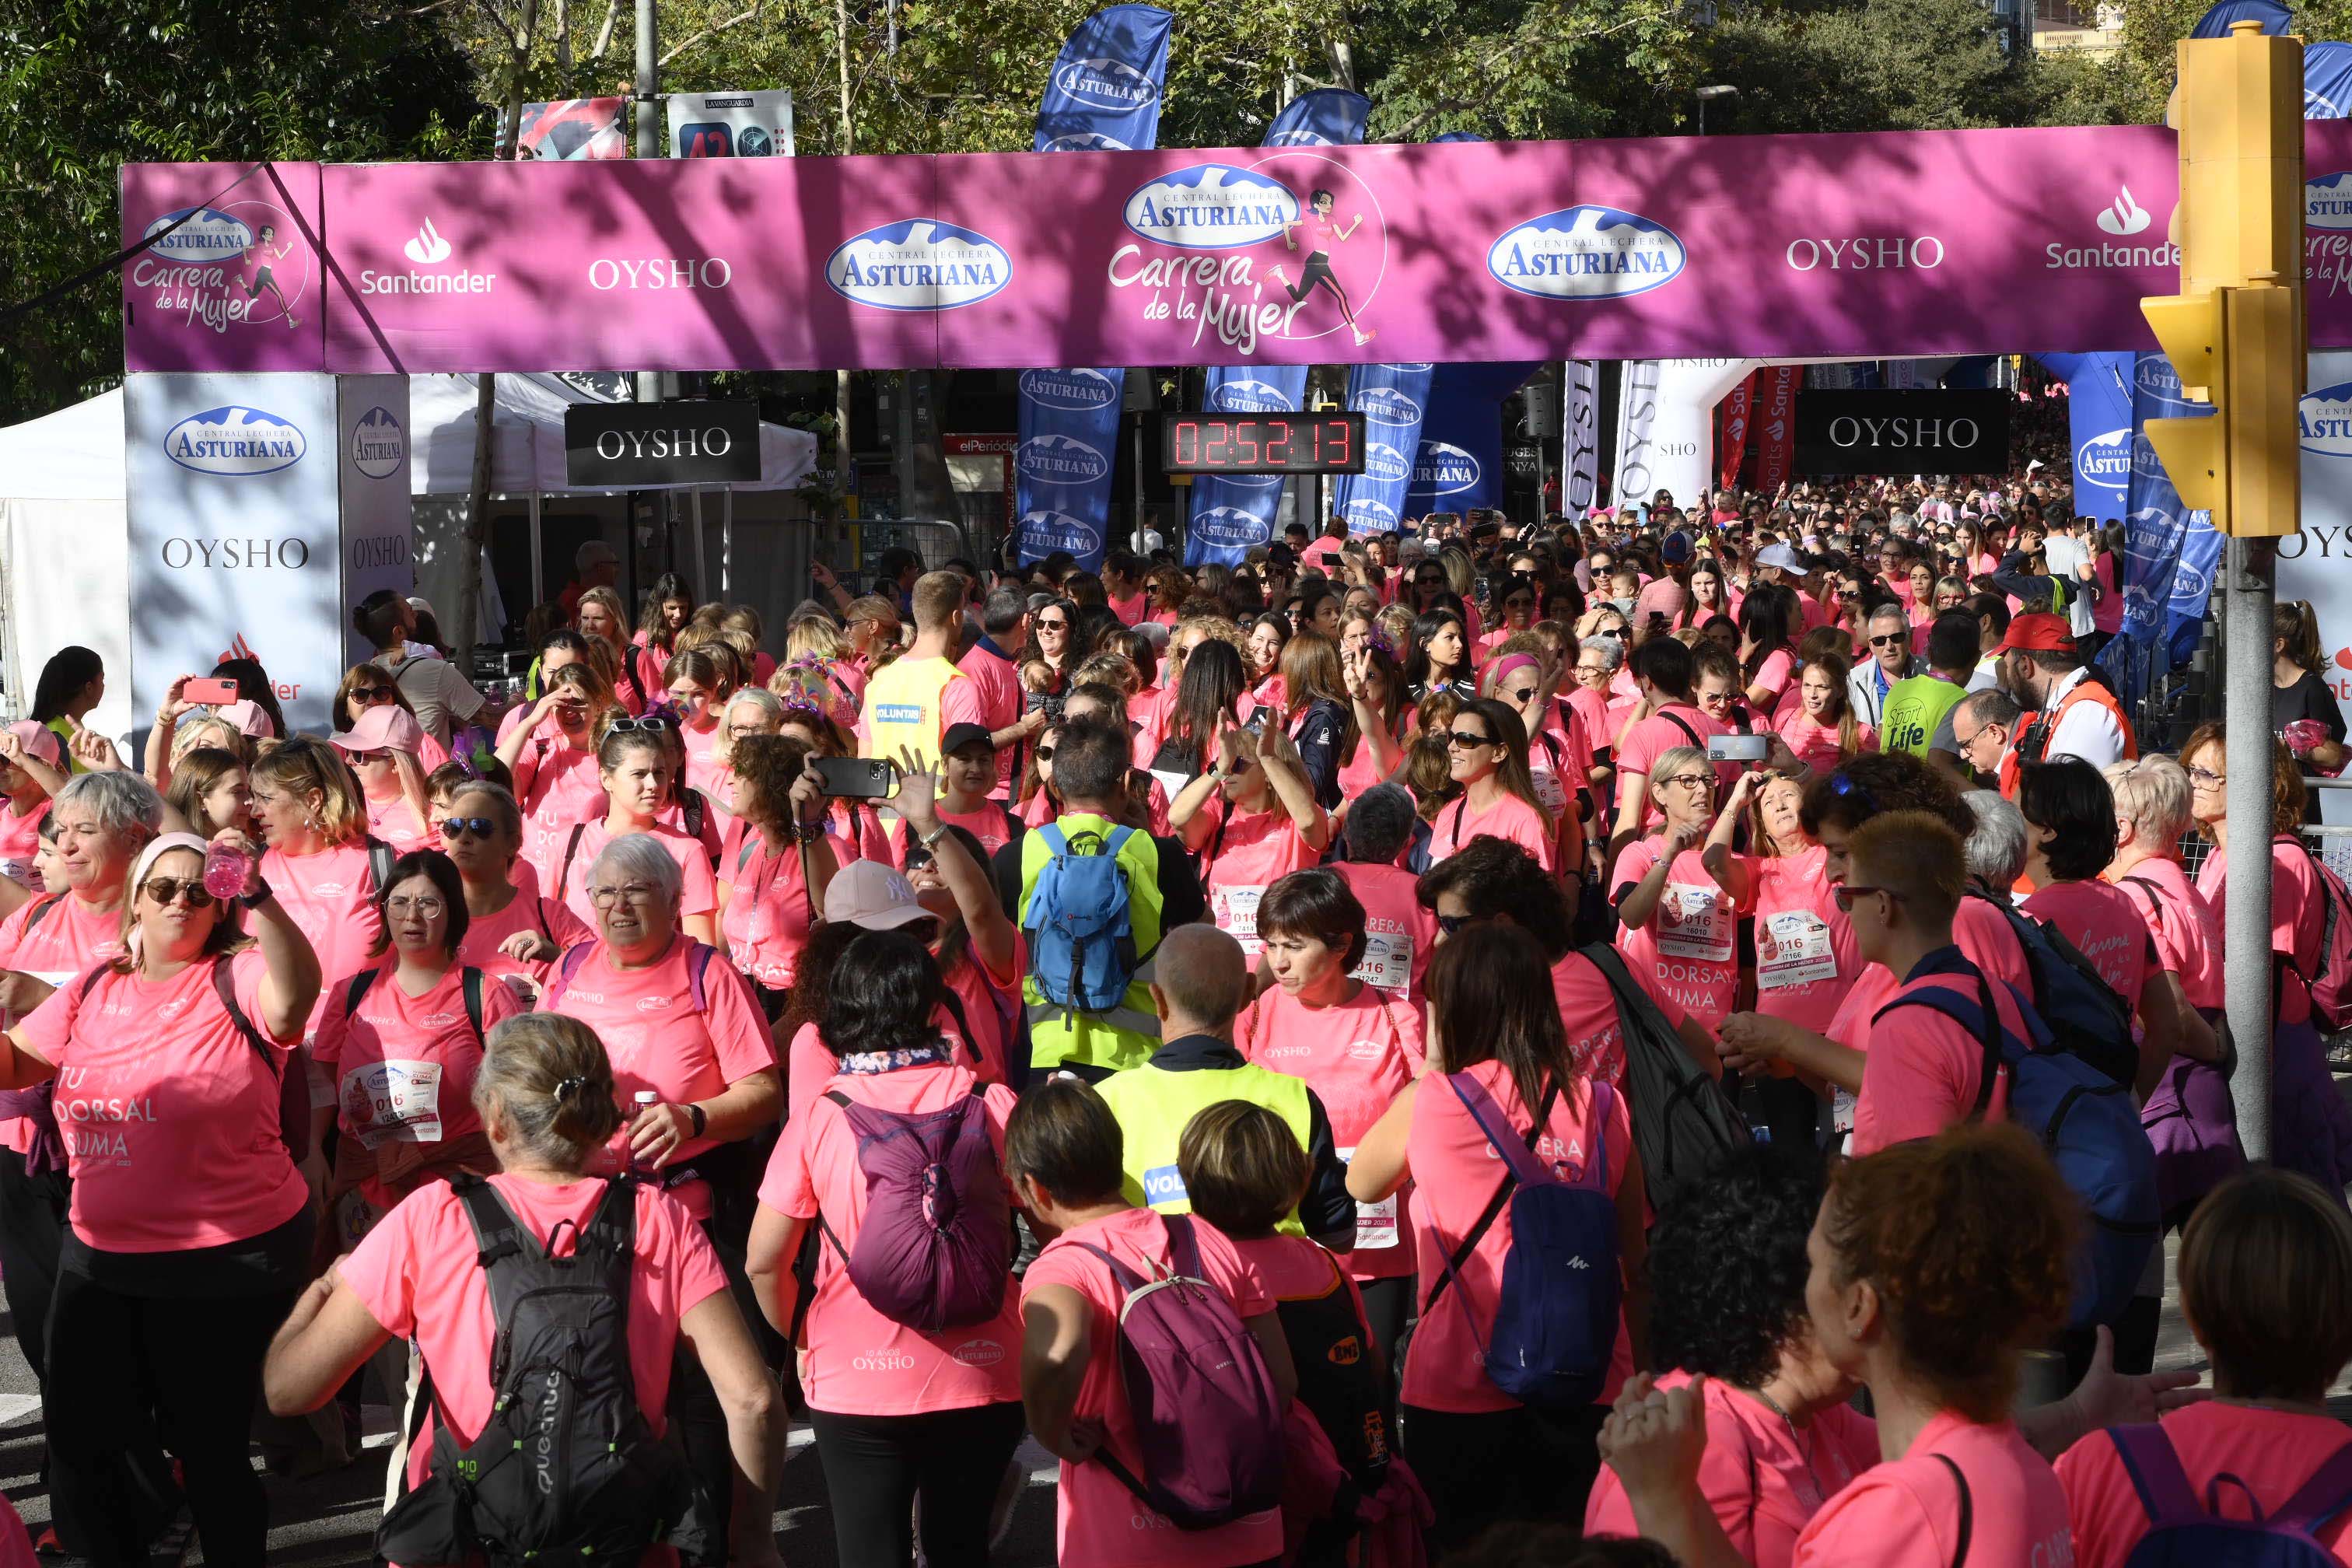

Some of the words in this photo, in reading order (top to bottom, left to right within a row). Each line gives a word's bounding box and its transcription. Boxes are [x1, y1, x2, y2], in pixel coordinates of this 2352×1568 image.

[1062, 70, 1148, 102] ASTURIANA
[1164, 193, 1219, 202] CENTRAL
[1225, 192, 1281, 201] LECHERA
[1136, 196, 1285, 227] ASTURIANA
[1533, 238, 1595, 248] CENTRAL
[1601, 236, 1665, 247] LECHERA
[1787, 236, 1944, 271] OYSHO
[868, 250, 926, 260] CENTRAL
[933, 249, 992, 260] LECHERA
[1108, 243, 1254, 288] Carrera
[1503, 243, 1670, 277] ASTURIANA
[2046, 241, 2182, 269] Santande
[133, 259, 226, 288] Carrera
[588, 257, 733, 291] OYSHO
[839, 254, 997, 287] ASTURIANA
[2318, 257, 2332, 279] la
[360, 268, 496, 294] Santander
[156, 289, 173, 310] de
[176, 289, 189, 310] la
[187, 285, 260, 334] Mujer
[1143, 289, 1171, 320] de
[1176, 288, 1197, 320] la
[1192, 282, 1308, 355] Mujer
[1027, 373, 1108, 402] ASTURIANA
[1356, 396, 1415, 422] ASTURIANA
[597, 427, 732, 460] OYSHO
[1175, 421, 1350, 465] 02:52:13
[1829, 417, 1979, 448] OYSHO
[175, 432, 297, 458] ASTURIANA
[355, 433, 401, 461] ASTURIANA
[1022, 448, 1100, 475] ASTURIANA
[1366, 458, 1403, 477] TURIANA
[1020, 530, 1092, 552] STURIANA
[1196, 518, 1262, 541] ASTURIANA
[162, 537, 309, 569] OYSHO
[353, 534, 405, 569] OYSHO
[1888, 705, 1923, 728] Sport
[1888, 722, 1924, 752] Life
[1234, 913, 1258, 922] 016
[1365, 918, 1406, 935] RERA
[1684, 913, 1711, 926] 016
[1686, 926, 1707, 936] 16010
[1661, 943, 1685, 952] OYSHO
[1778, 937, 1804, 952] 016
[1782, 951, 1802, 961] 17166
[1356, 961, 1383, 973] 016
[1764, 973, 1786, 982] OYSHO
[1804, 966, 1830, 976] Santander
[566, 989, 604, 1003] OYSHO
[355, 1016, 397, 1026] OYSHO
[1264, 1045, 1312, 1059] OYSHO
[58, 1066, 87, 1090] TU
[52, 1098, 157, 1122] DORSAL
[376, 1093, 404, 1111] 016
[66, 1132, 128, 1157] SUMA
[853, 1356, 915, 1370] OYSHO
